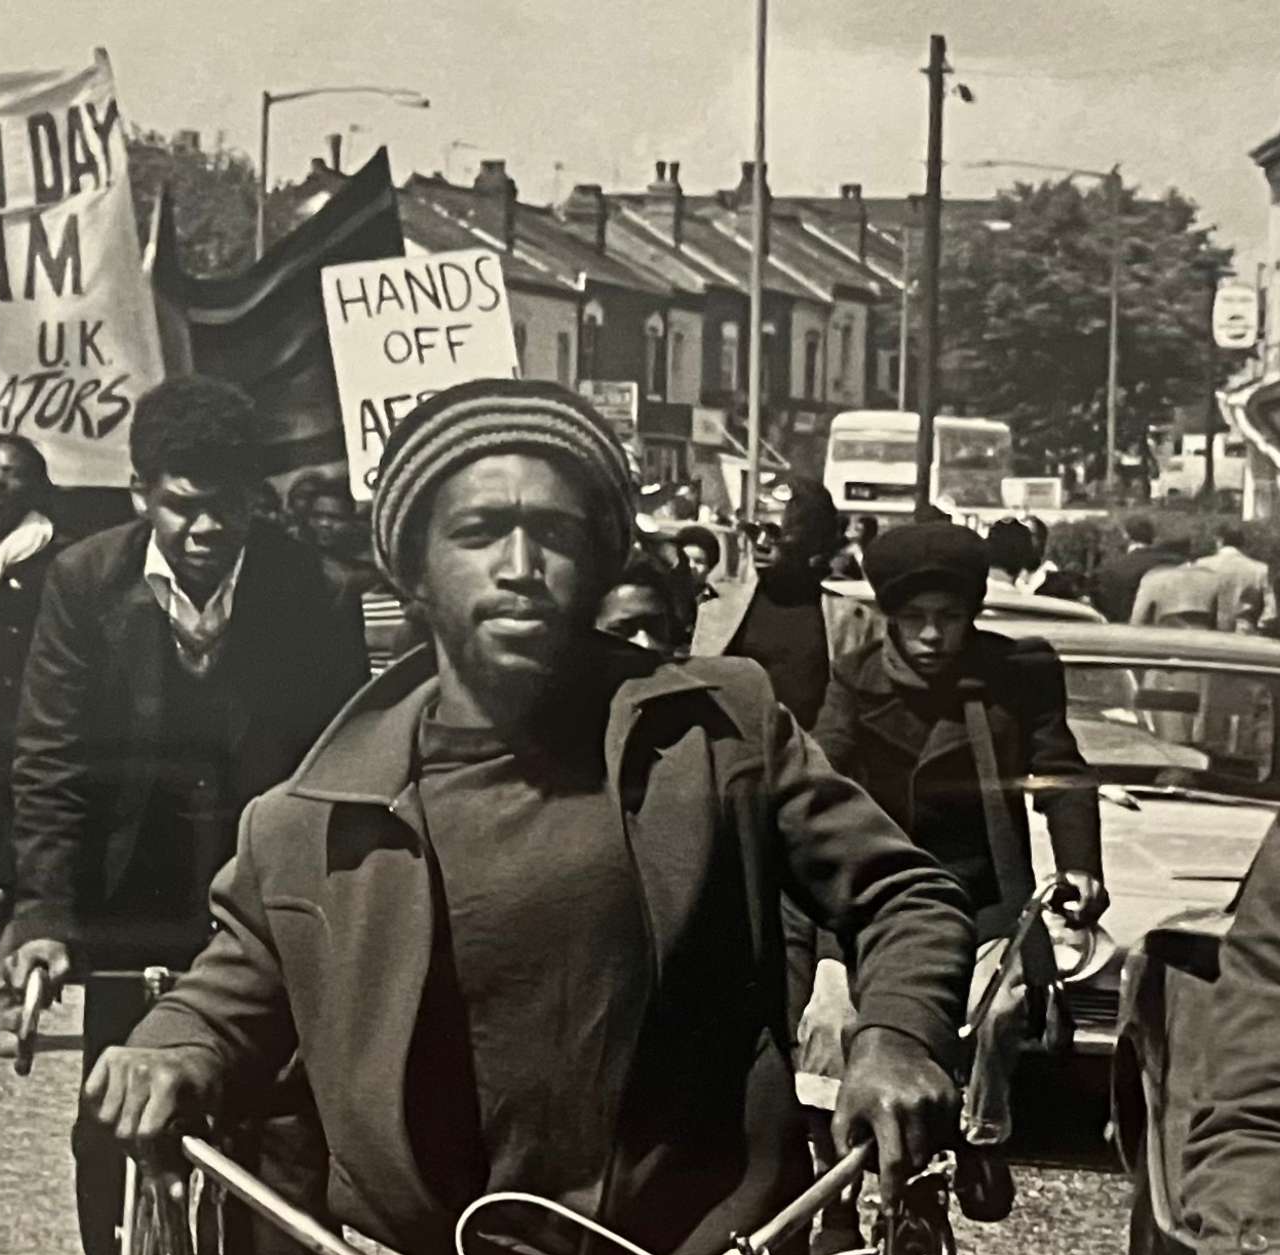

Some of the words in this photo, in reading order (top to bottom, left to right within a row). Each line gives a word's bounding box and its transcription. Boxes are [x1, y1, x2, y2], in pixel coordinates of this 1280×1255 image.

[27, 98, 119, 205] DAY
[335, 256, 500, 324] HANDS
[383, 323, 473, 365] OFF
